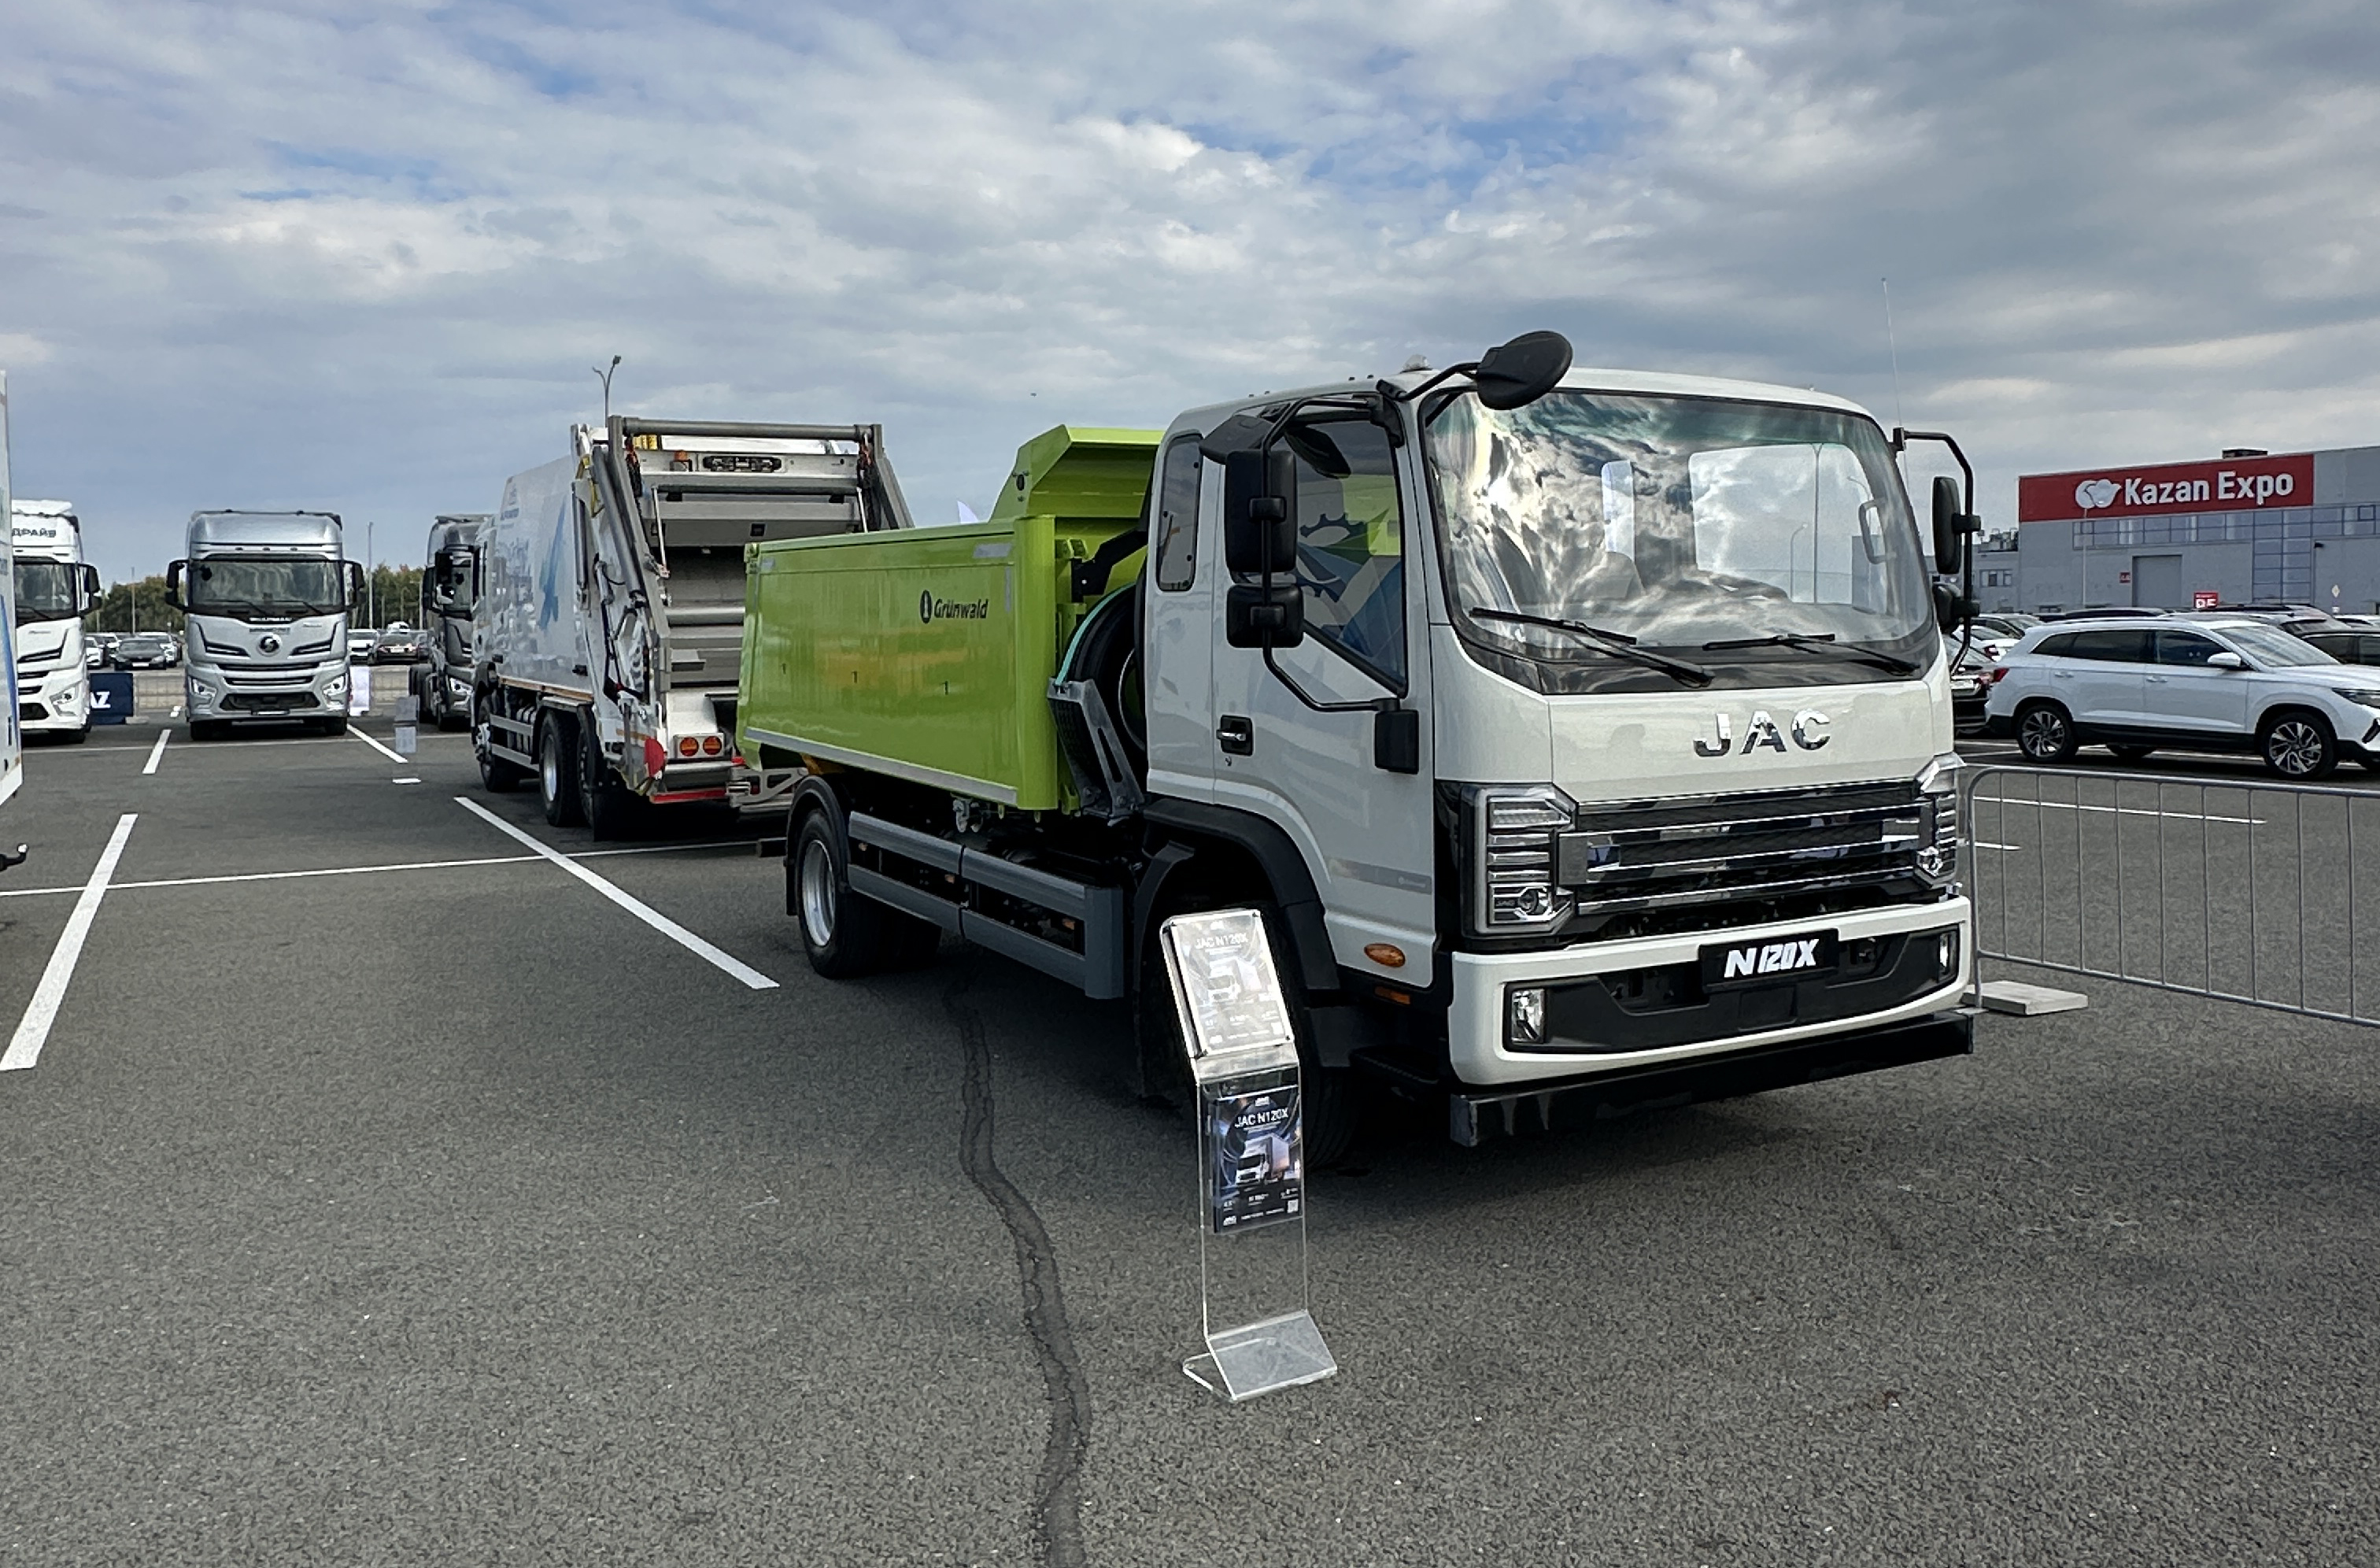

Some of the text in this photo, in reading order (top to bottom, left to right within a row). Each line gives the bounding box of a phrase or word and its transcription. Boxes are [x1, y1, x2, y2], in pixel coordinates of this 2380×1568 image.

[2124, 471, 2294, 506] Kazan Expo
[934, 598, 989, 619] Grünwald
[1693, 708, 1831, 758] JAC
[1195, 936, 1215, 950] JAC
[1723, 938, 1820, 978] N120X
[1234, 1114, 1257, 1129] JAC
[1257, 1107, 1289, 1123] N120X
